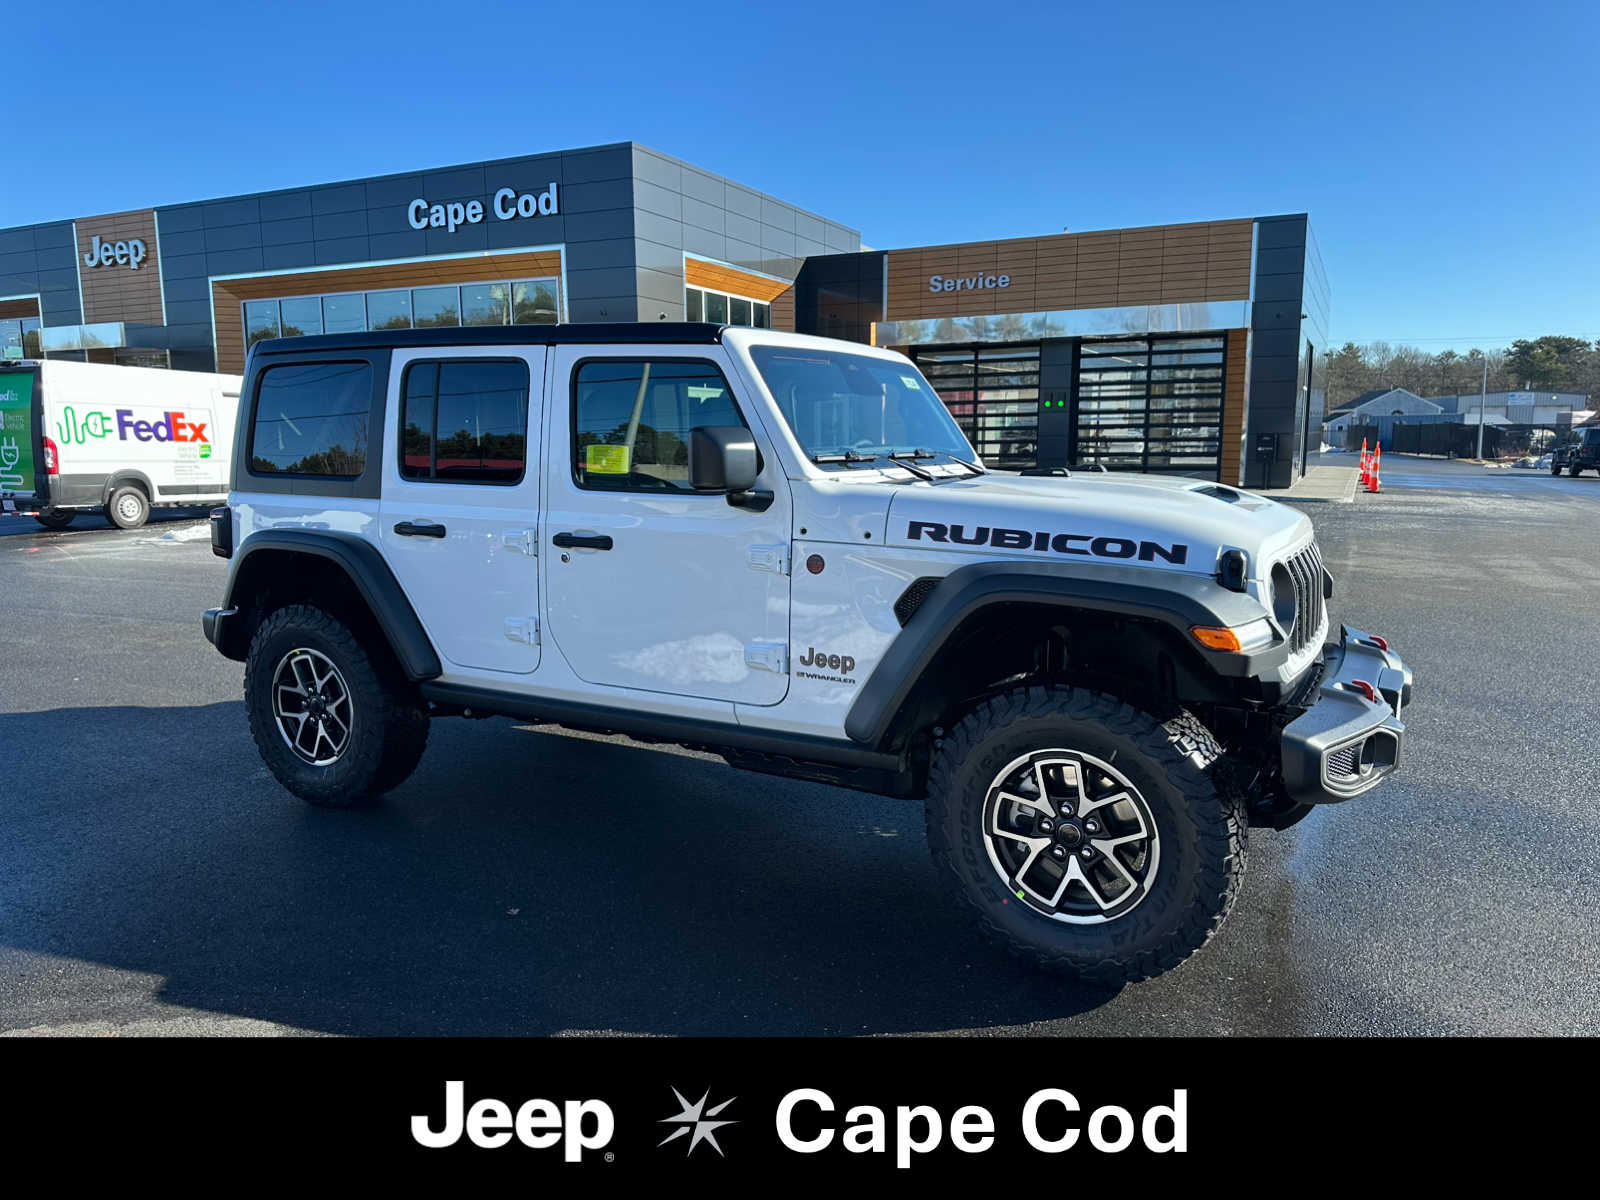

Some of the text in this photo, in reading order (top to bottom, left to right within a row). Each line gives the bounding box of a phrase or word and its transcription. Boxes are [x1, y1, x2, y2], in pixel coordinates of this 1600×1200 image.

[408, 182, 558, 233] Cape Cod
[83, 235, 147, 270] Jeep
[929, 272, 1011, 293] Service
[116, 409, 209, 443] FedEx
[907, 521, 1188, 565] RUBICON
[800, 647, 855, 675] Jeep
[805, 671, 856, 684] WRANGLER
